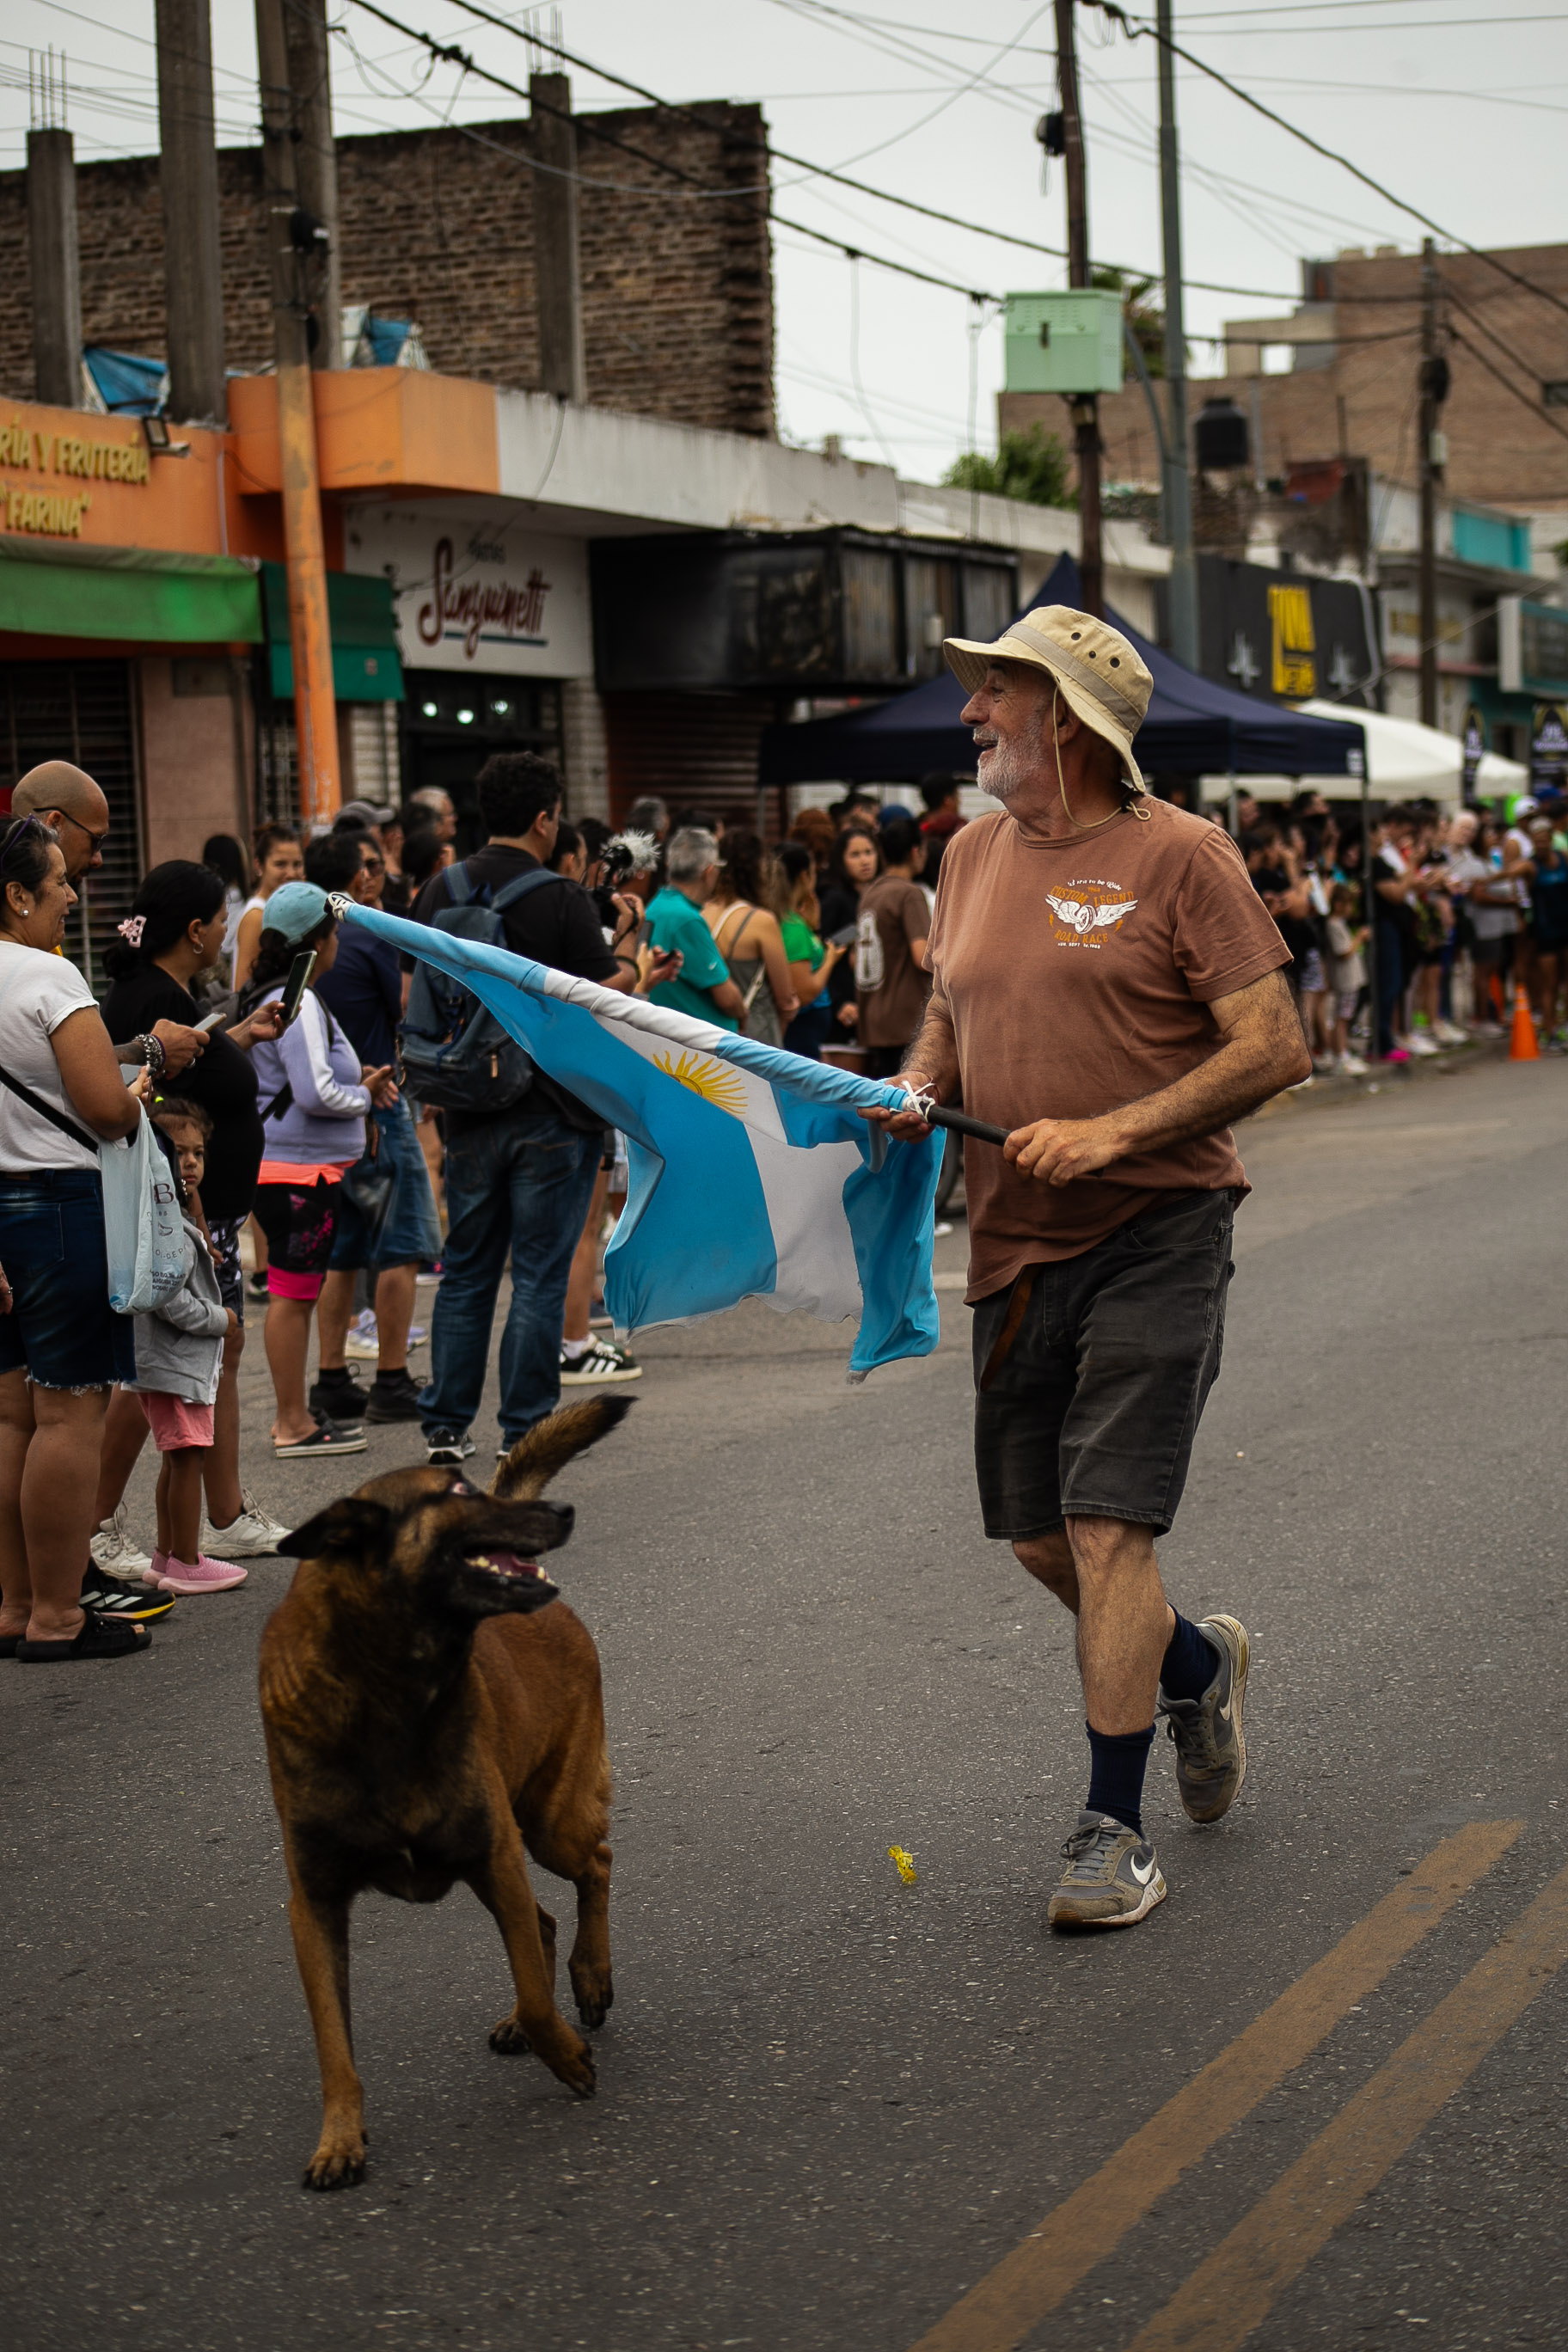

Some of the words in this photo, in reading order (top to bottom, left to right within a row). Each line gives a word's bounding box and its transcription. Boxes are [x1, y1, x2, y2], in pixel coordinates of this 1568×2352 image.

[34, 432, 53, 472] Y
[55, 431, 150, 486] FRUTERÍA
[418, 536, 553, 661] Sanguinetti
[1050, 885, 1089, 905] CUSTOM
[1094, 891, 1134, 907] LEGEND
[1055, 929, 1079, 942] ROAD
[1082, 933, 1108, 944] RACE
